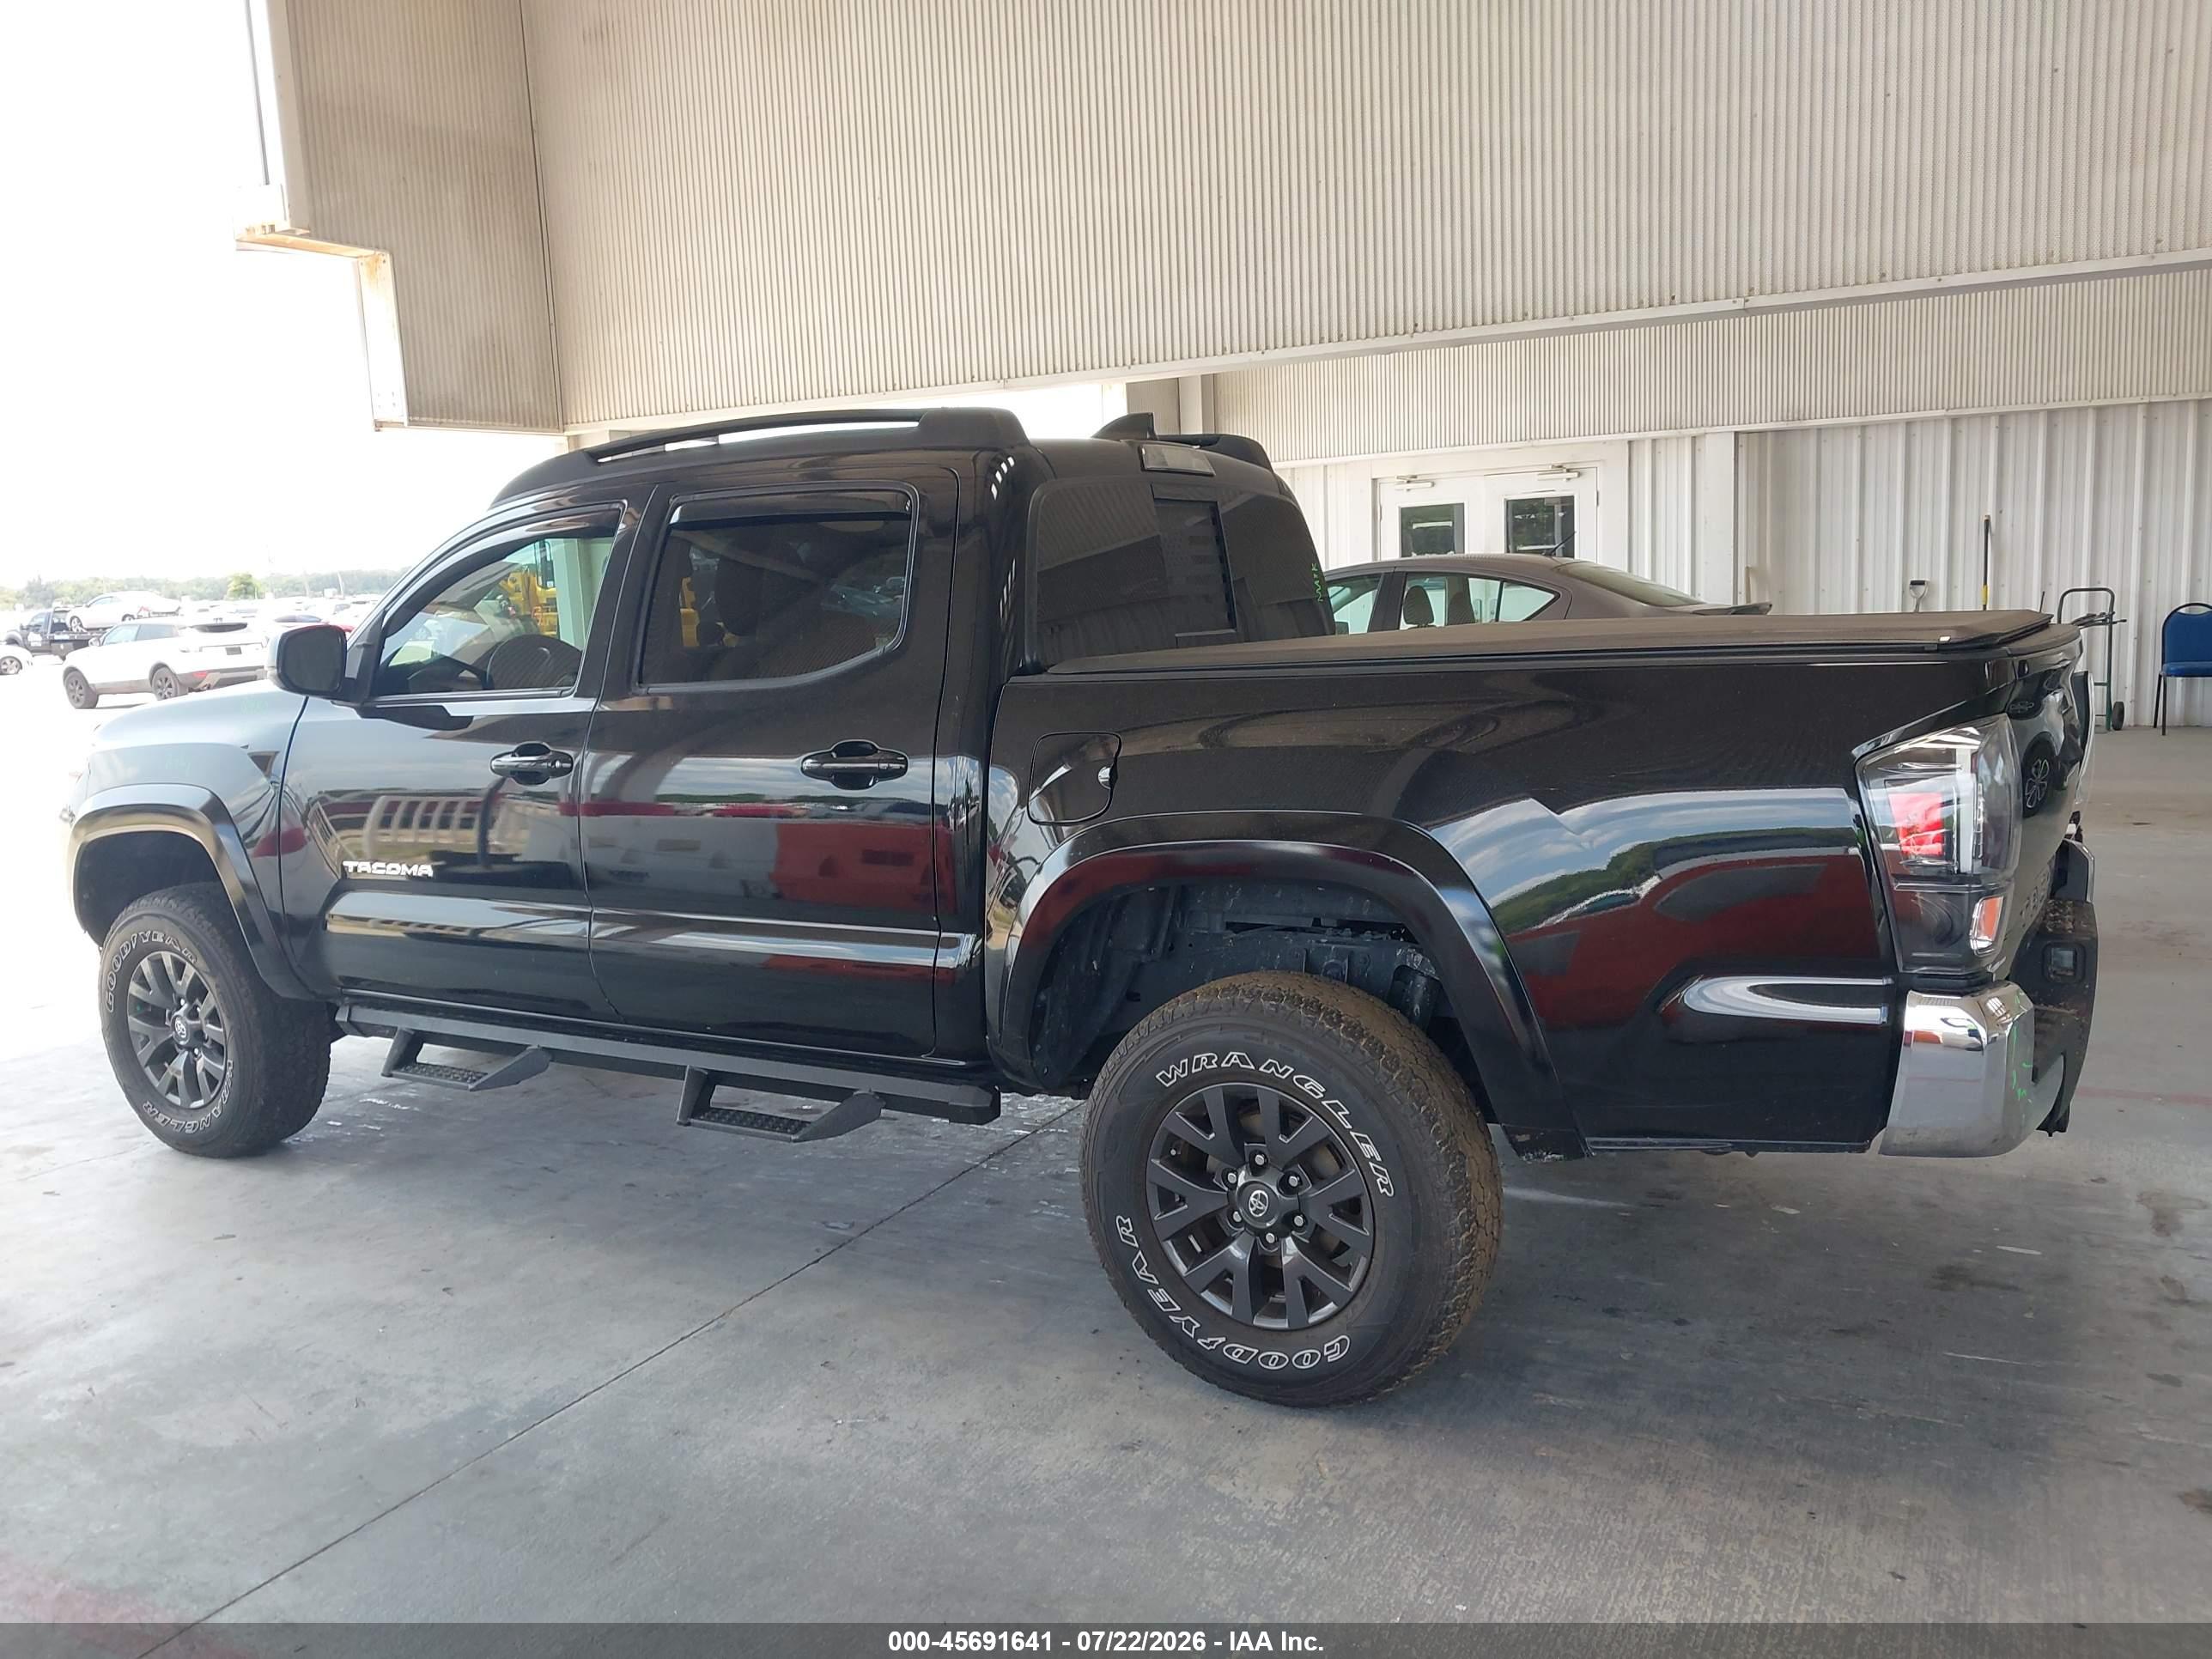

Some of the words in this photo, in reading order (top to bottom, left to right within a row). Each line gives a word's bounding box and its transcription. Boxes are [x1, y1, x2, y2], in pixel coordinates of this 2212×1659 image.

[342, 860, 434, 877] TACOMA
[106, 930, 198, 1013] GOODYEAR
[1155, 1051, 1395, 1198] WRANGLER
[1115, 1214, 1351, 1370] GOODYEAR
